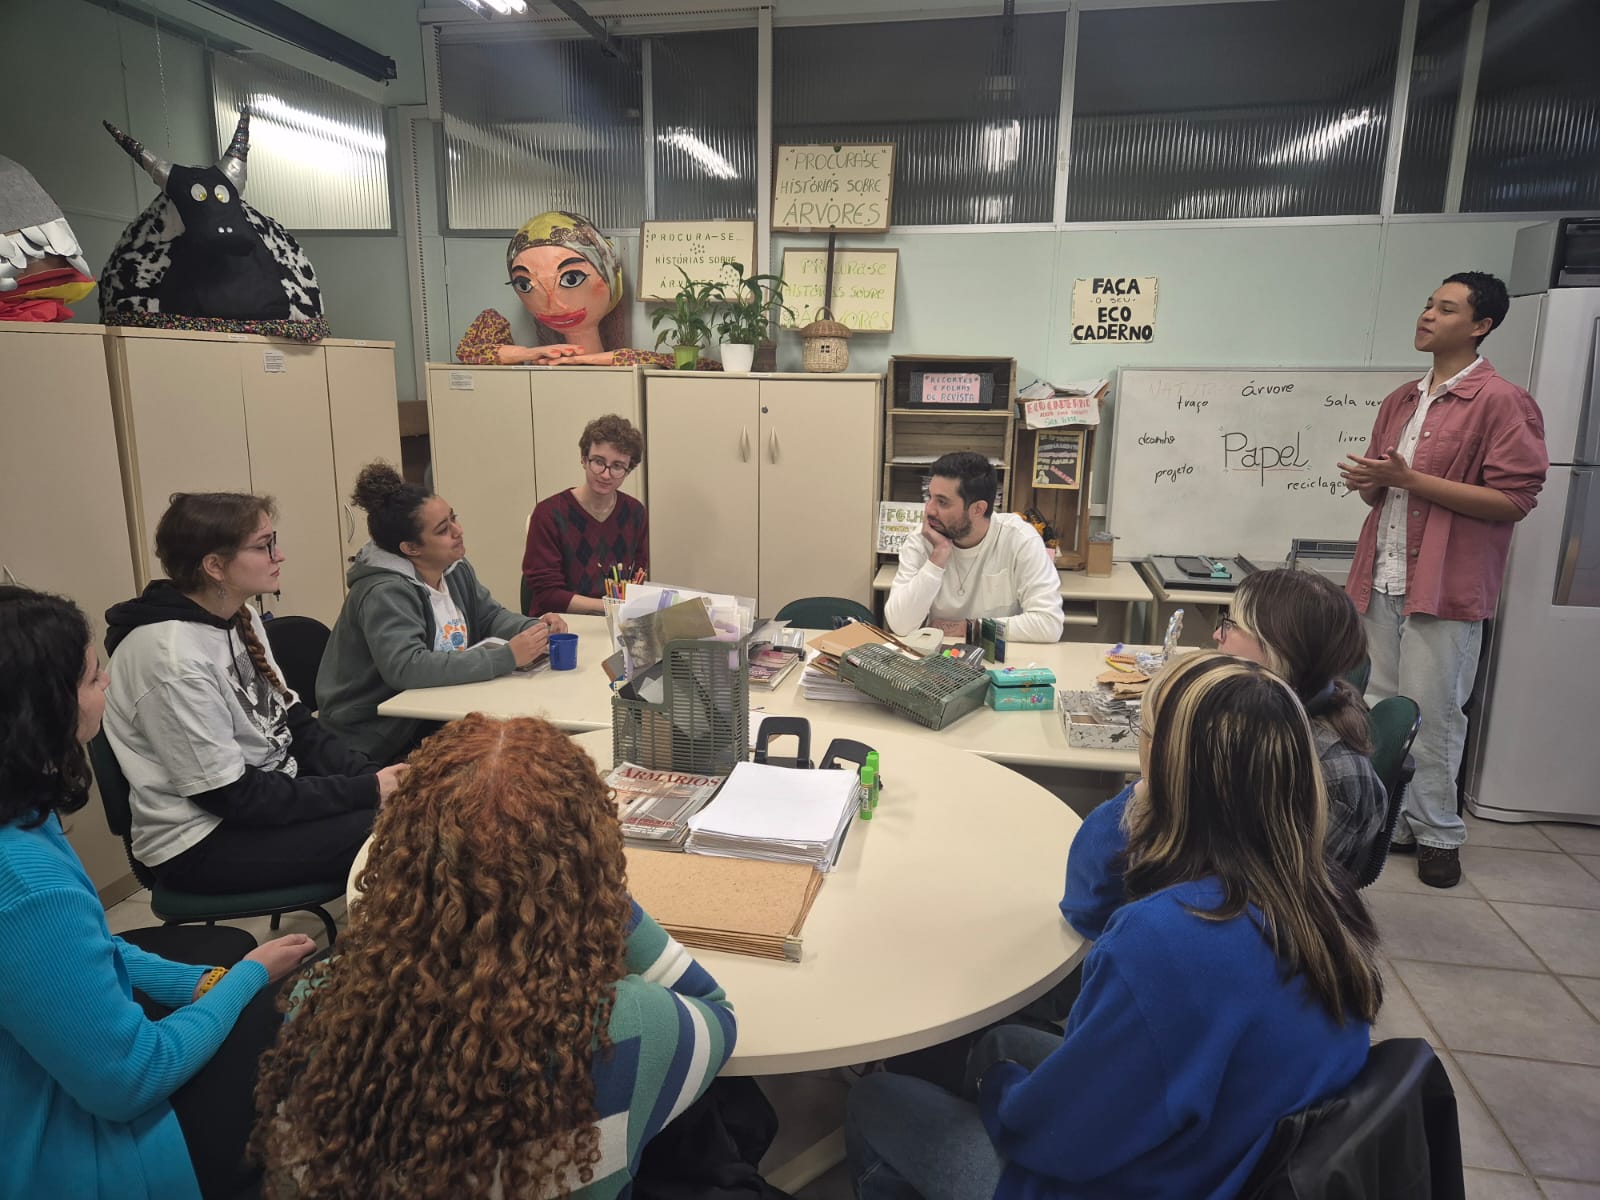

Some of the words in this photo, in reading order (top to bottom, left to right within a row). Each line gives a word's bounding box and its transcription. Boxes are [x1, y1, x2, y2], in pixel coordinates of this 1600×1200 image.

[847, 178, 881, 193] SOBRE
[783, 199, 881, 226] ÁRVORES
[1092, 278, 1141, 296] FAÇA
[1098, 306, 1132, 323] ECO
[1073, 323, 1153, 341] CADERNO
[1241, 379, 1296, 397] árvore
[1177, 395, 1209, 414] traço
[1324, 393, 1357, 407] Sala
[1338, 431, 1366, 442] livro
[1154, 463, 1194, 484] projeto
